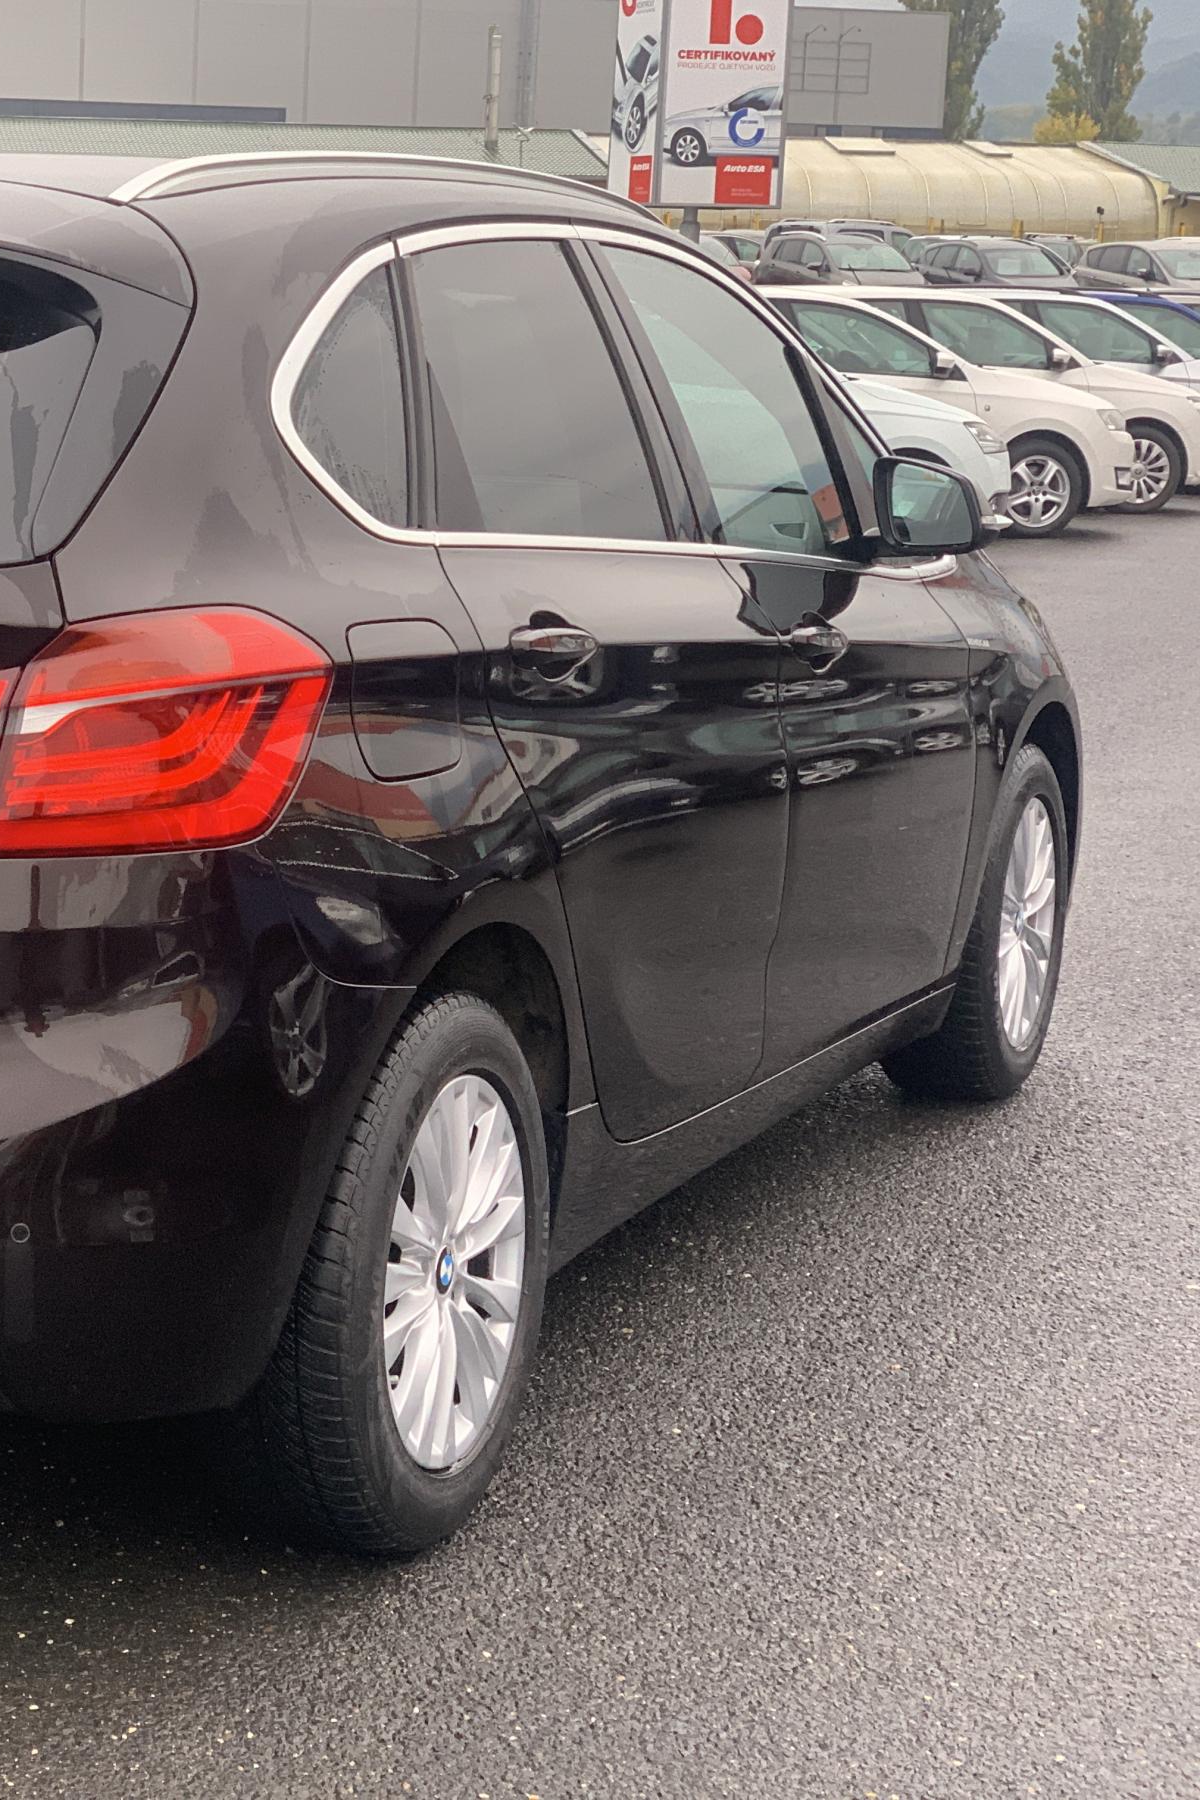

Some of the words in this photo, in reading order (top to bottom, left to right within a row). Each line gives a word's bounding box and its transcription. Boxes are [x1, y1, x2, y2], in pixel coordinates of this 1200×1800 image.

[678, 49, 776, 62] CERTIFIKOVANÝ
[723, 165, 746, 173] Auto
[747, 165, 766, 173] ESA
